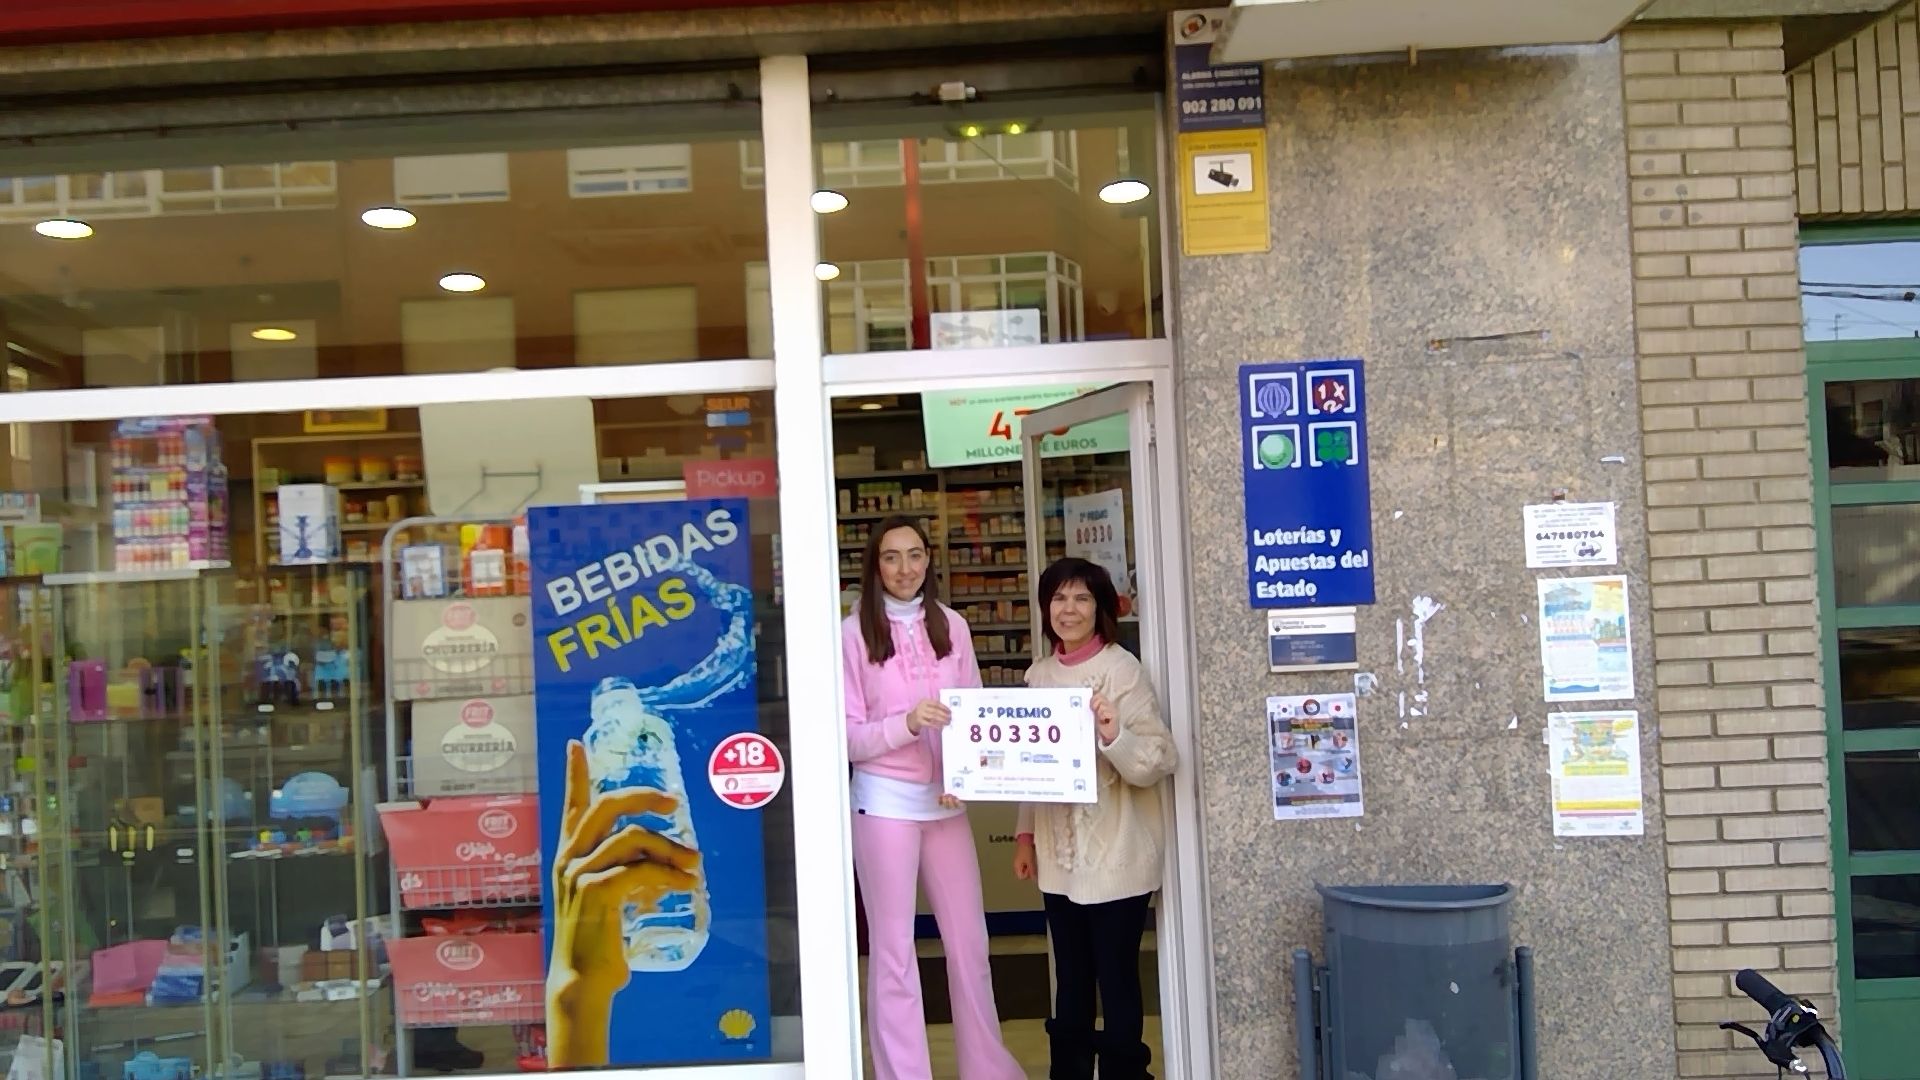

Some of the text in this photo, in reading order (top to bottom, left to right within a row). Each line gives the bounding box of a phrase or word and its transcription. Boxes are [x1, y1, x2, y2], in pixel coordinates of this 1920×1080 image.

[1182, 99, 1207, 114] 902
[966, 444, 1022, 459] MILLONE
[1053, 437, 1098, 452] EUROS
[1076, 524, 1113, 545] 80330
[1253, 525, 1342, 547] Loterías y
[546, 509, 739, 616] BEBIDAS
[1254, 549, 1369, 576] Apuestas del
[1256, 578, 1318, 599] Estado
[547, 578, 696, 673] FRÍAS
[997, 706, 1052, 719] PREMIO
[970, 724, 1061, 743] 80330
[442, 739, 515, 754] CHURRERÍA
[724, 741, 767, 766] +18
[989, 834, 1017, 843] Lote
